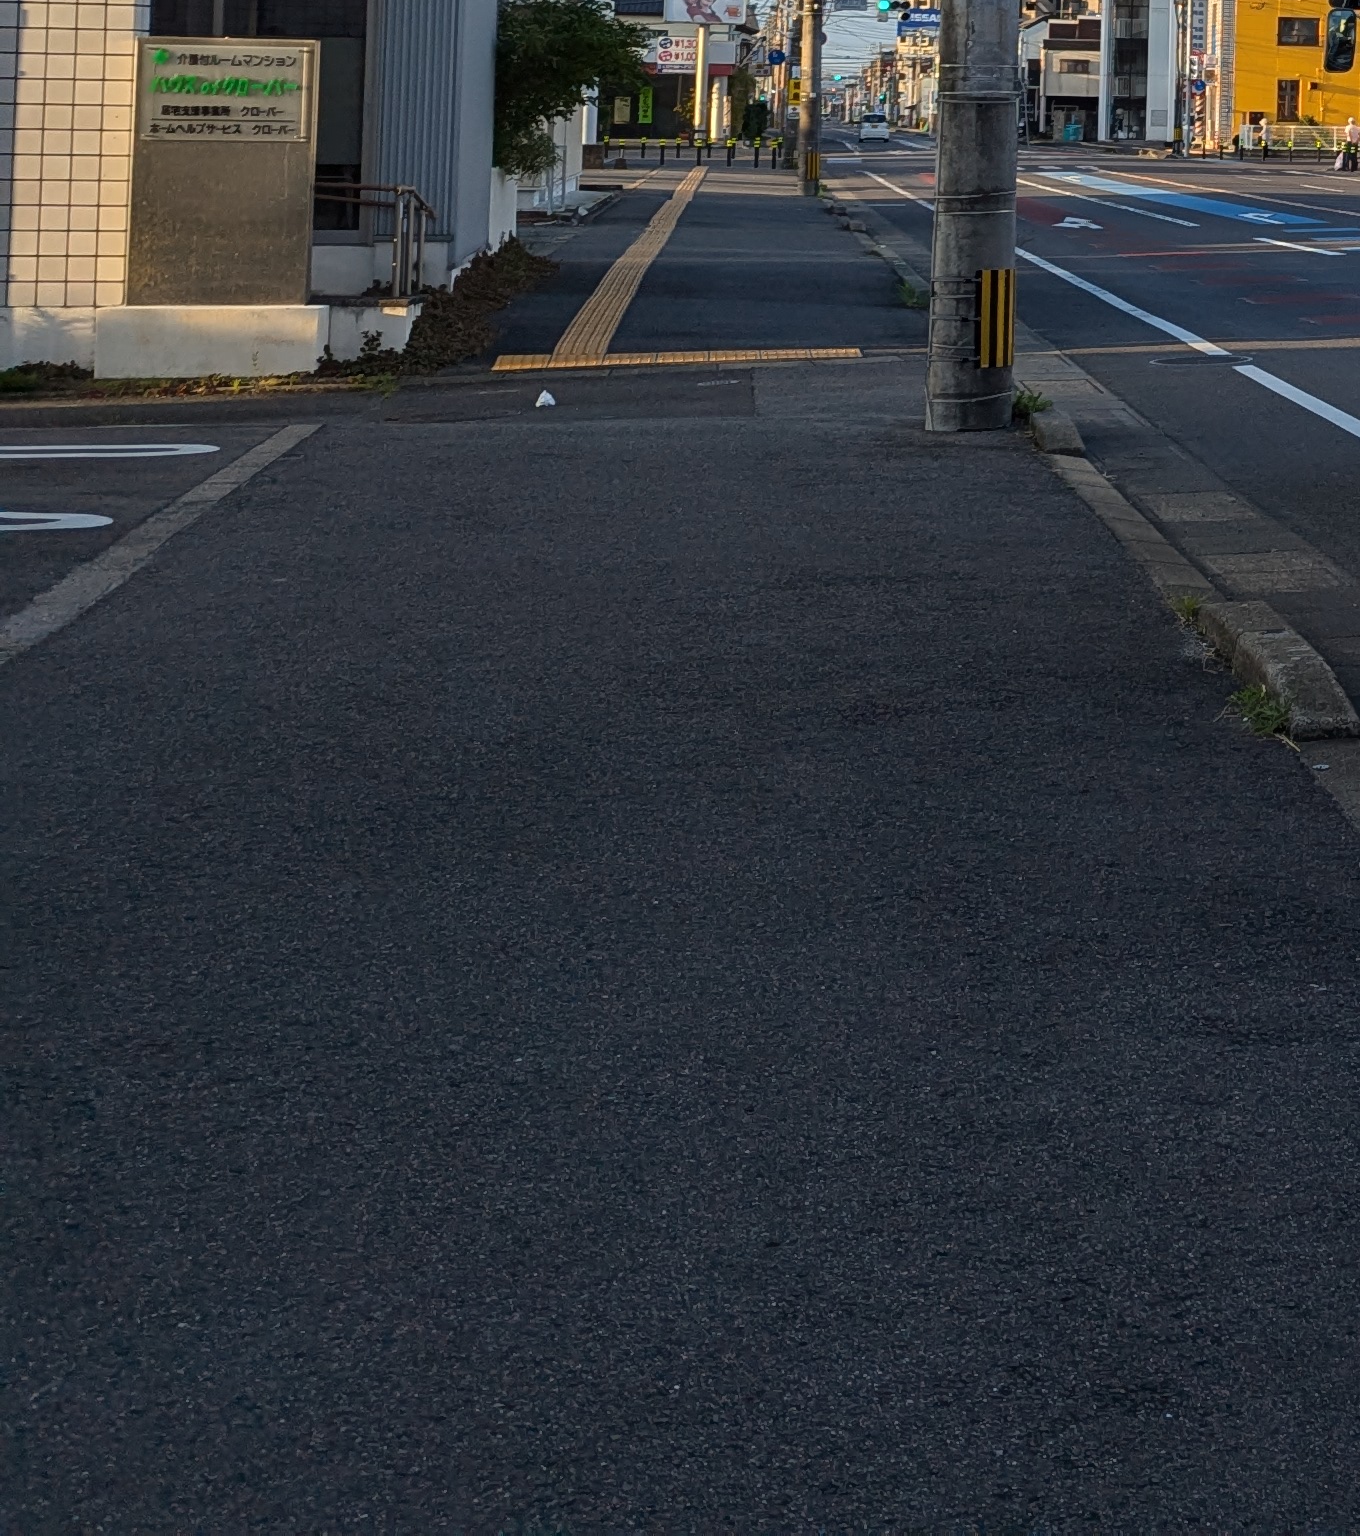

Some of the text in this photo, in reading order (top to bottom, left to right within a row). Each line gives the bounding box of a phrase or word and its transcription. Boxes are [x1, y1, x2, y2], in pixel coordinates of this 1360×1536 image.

[240, 106, 285, 117] クローバー
[150, 124, 296, 135] ホームヘルプサービス クローバー
